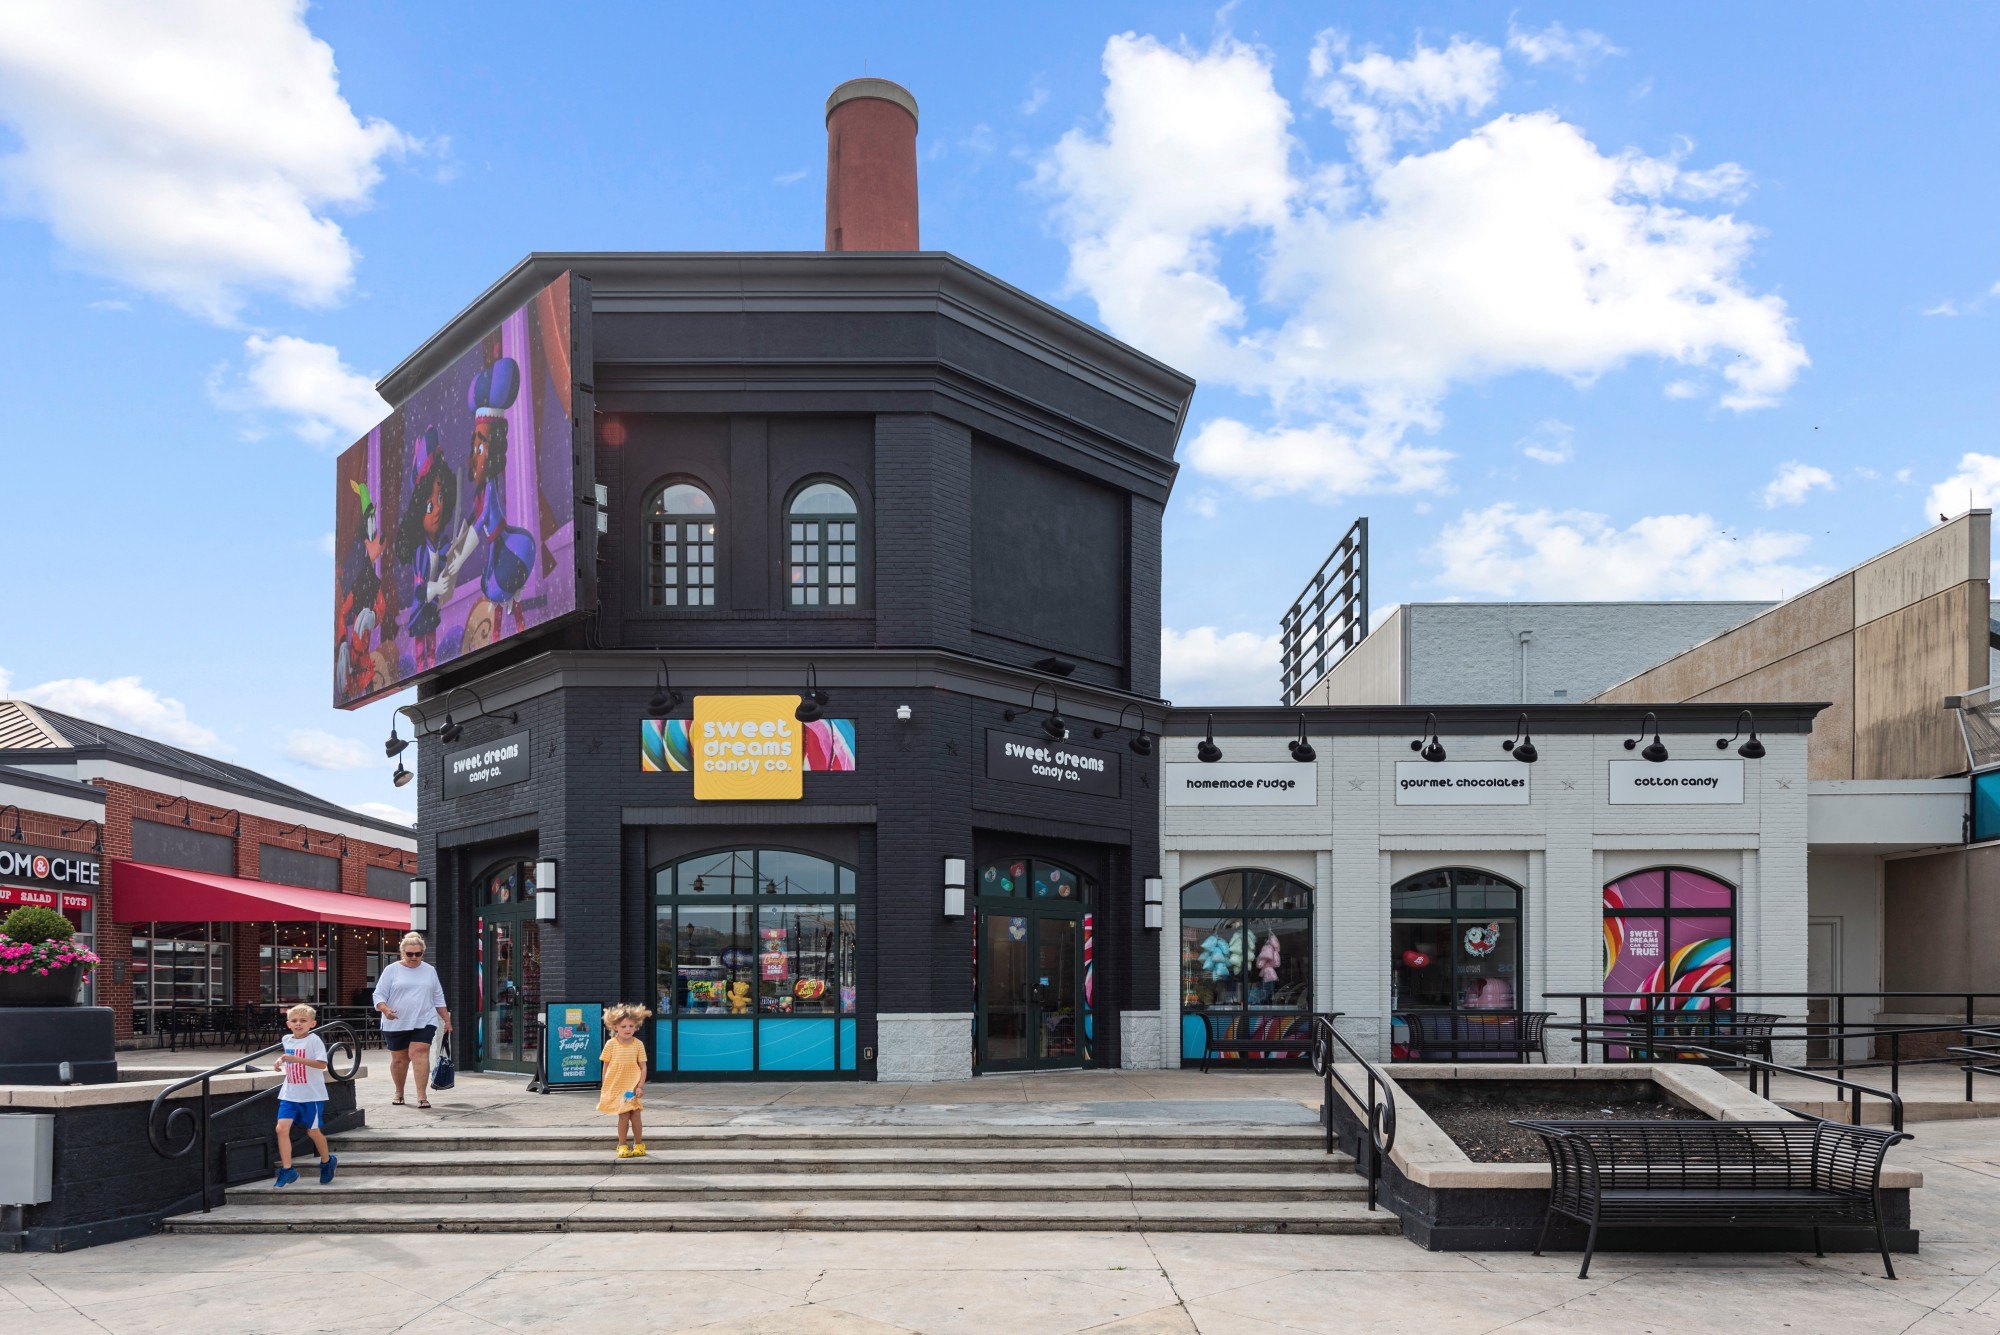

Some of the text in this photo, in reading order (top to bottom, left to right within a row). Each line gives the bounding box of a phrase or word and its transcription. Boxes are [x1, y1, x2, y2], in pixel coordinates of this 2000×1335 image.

[703, 719, 792, 738] sweet
[703, 740, 792, 757] dreams
[453, 743, 519, 774] sweet dreams
[1005, 742, 1104, 772] sweet dreams
[469, 766, 501, 782] candy co.
[703, 759, 792, 776] candy co.
[1031, 764, 1081, 781] candy co.
[1186, 779, 1296, 791] homemade fudge
[1400, 778, 1525, 790] gourmet chocolates
[1634, 777, 1718, 789] cotton candy
[51, 857, 99, 885] CHEE
[20, 892, 52, 903] SALAD
[64, 896, 87, 906] TOTS
[1630, 948, 1659, 956] TRUE!
[558, 1026, 573, 1039] 15
[559, 1039, 589, 1051] Fudge!
